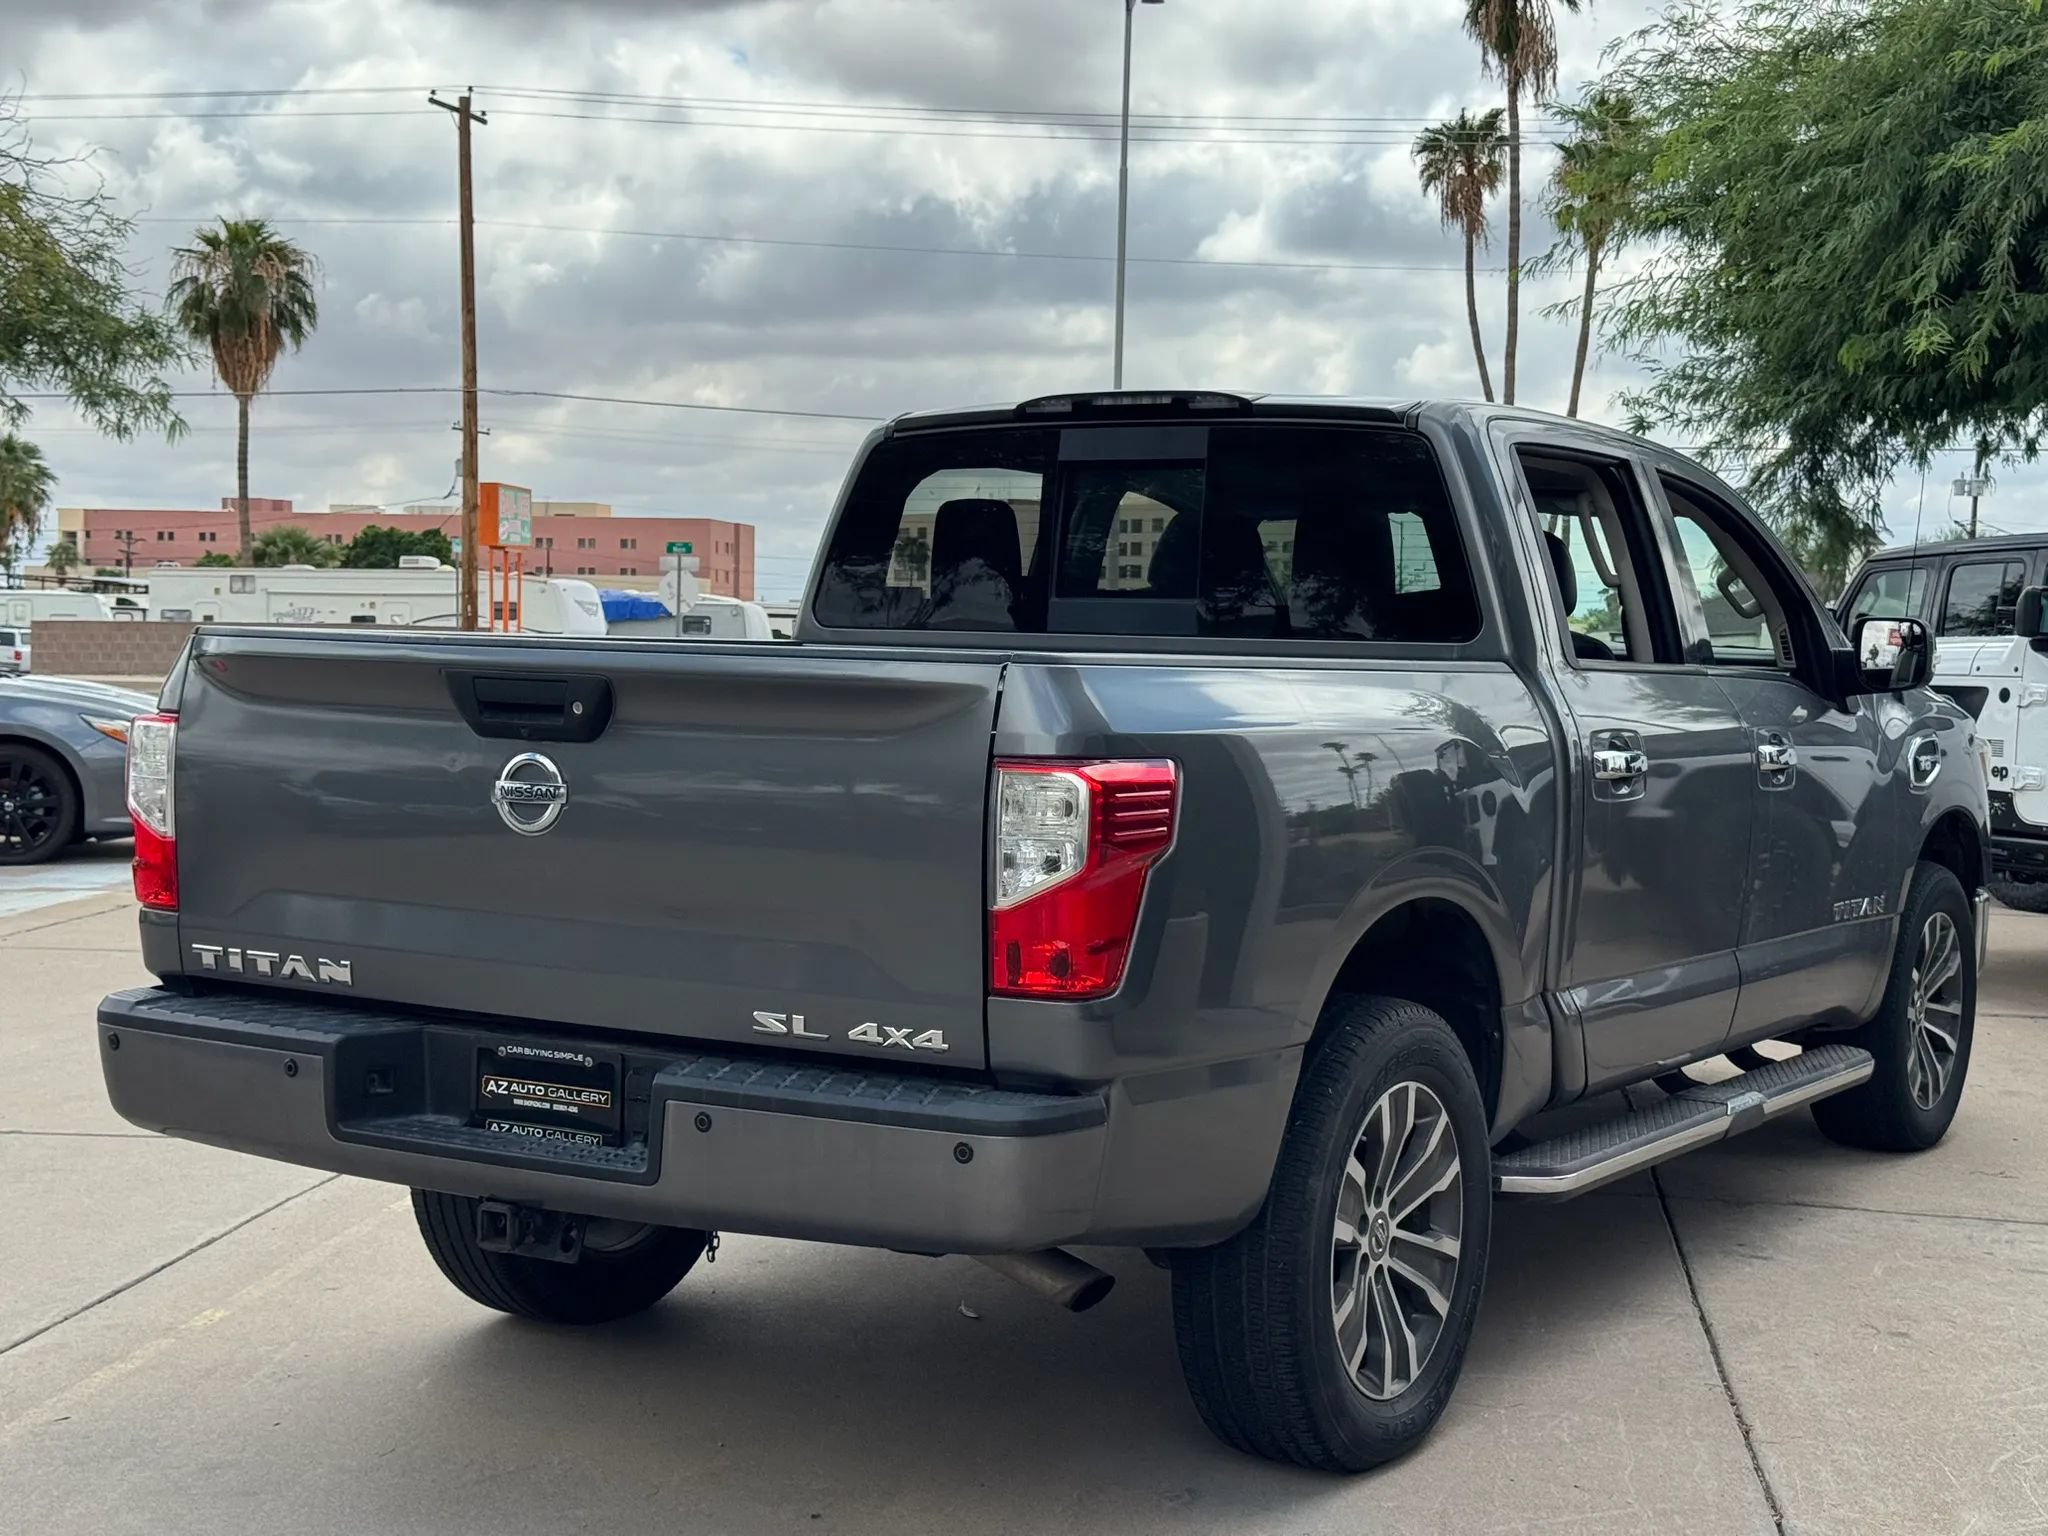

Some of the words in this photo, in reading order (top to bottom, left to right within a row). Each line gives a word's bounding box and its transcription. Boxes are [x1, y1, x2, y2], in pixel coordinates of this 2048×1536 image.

[1991, 765, 2009, 781] ep
[500, 784, 557, 800] NISSAN
[1833, 895, 1885, 921] TITAN
[192, 943, 353, 986] TITAN
[752, 1010, 831, 1041] SL
[506, 1045, 524, 1054] CAR
[524, 1047, 553, 1058] BUYING
[554, 1051, 584, 1062] SIMPLE
[486, 1080, 509, 1094] AZ
[510, 1083, 545, 1096] AUTO
[547, 1087, 608, 1104] GALLERY
[511, 1125, 543, 1138] AUTO
[545, 1130, 599, 1146] GALLERY
